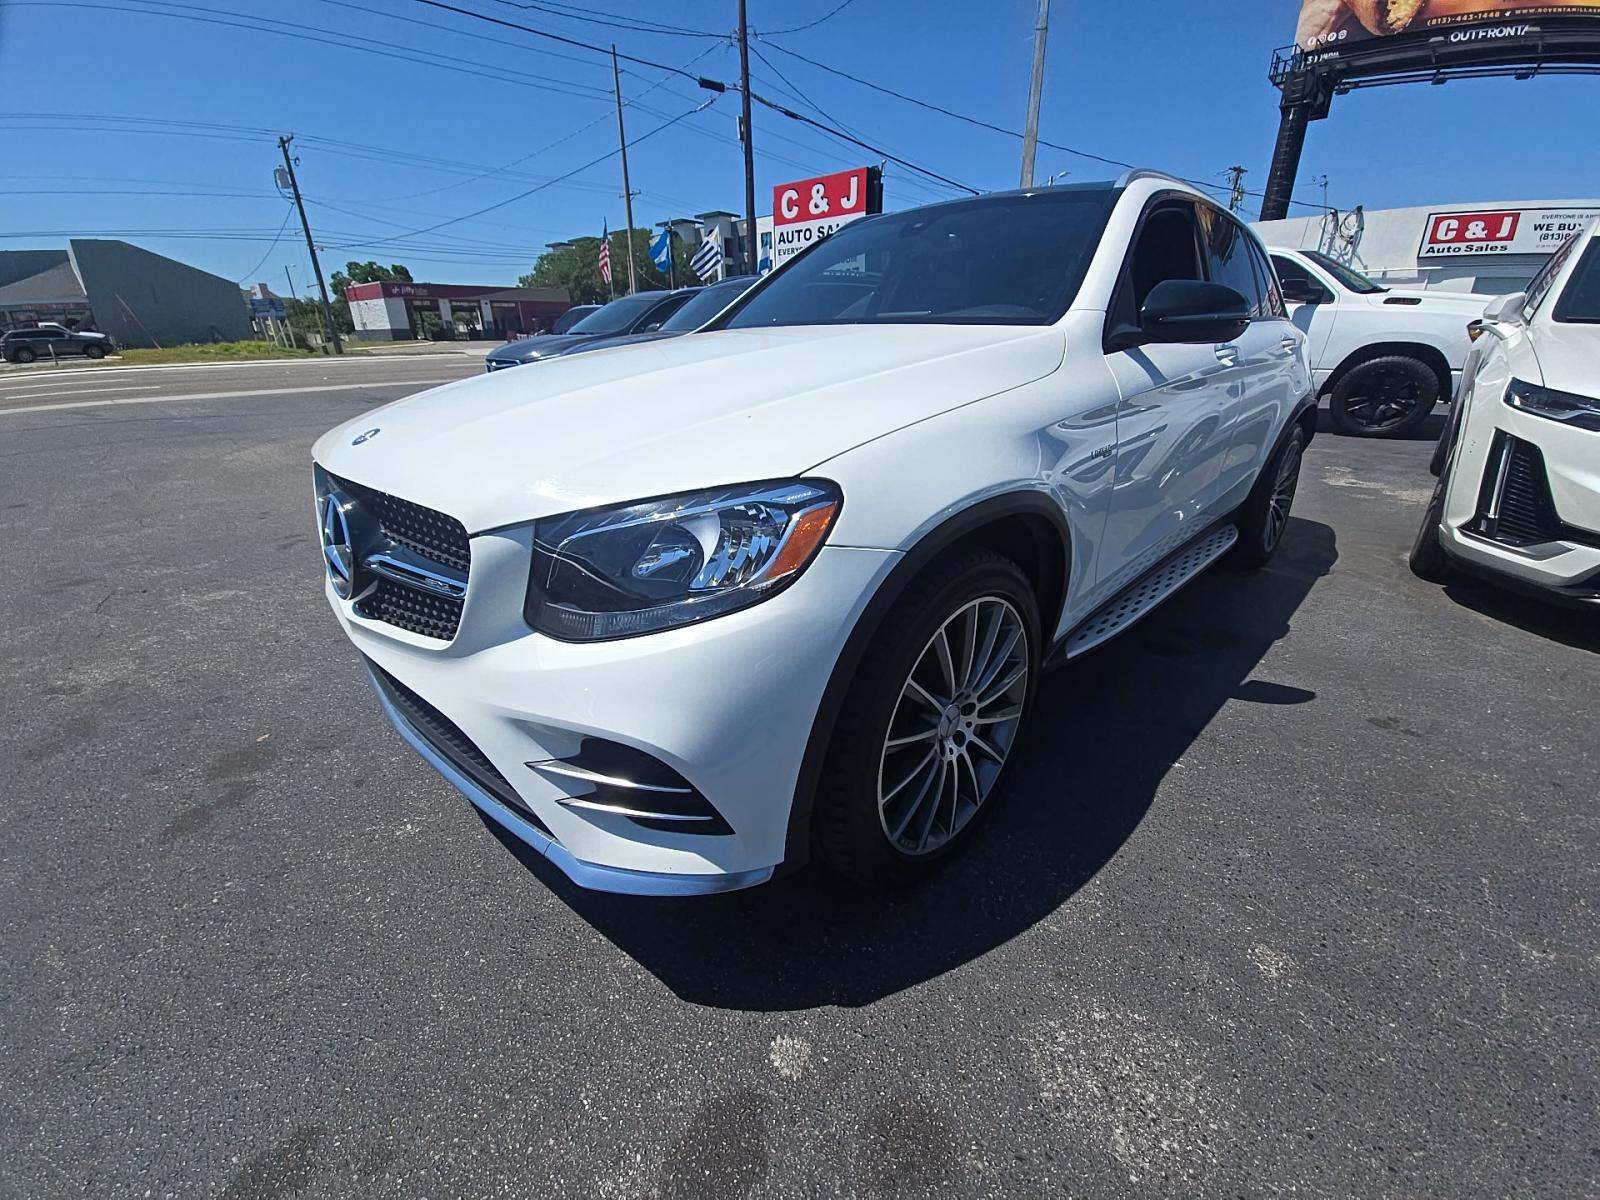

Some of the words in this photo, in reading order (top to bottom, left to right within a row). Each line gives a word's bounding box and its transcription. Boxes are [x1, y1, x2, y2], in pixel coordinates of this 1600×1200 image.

[781, 189, 799, 219] C
[808, 183, 830, 215] &
[840, 176, 858, 209] J
[778, 228, 813, 245] AUTO
[817, 223, 841, 238] SA
[1436, 219, 1459, 240] C
[1464, 220, 1488, 239] &
[1496, 216, 1513, 238] J
[1533, 223, 1554, 231] WE
[1425, 245, 1462, 255] Auto
[1464, 244, 1508, 253] Sales
